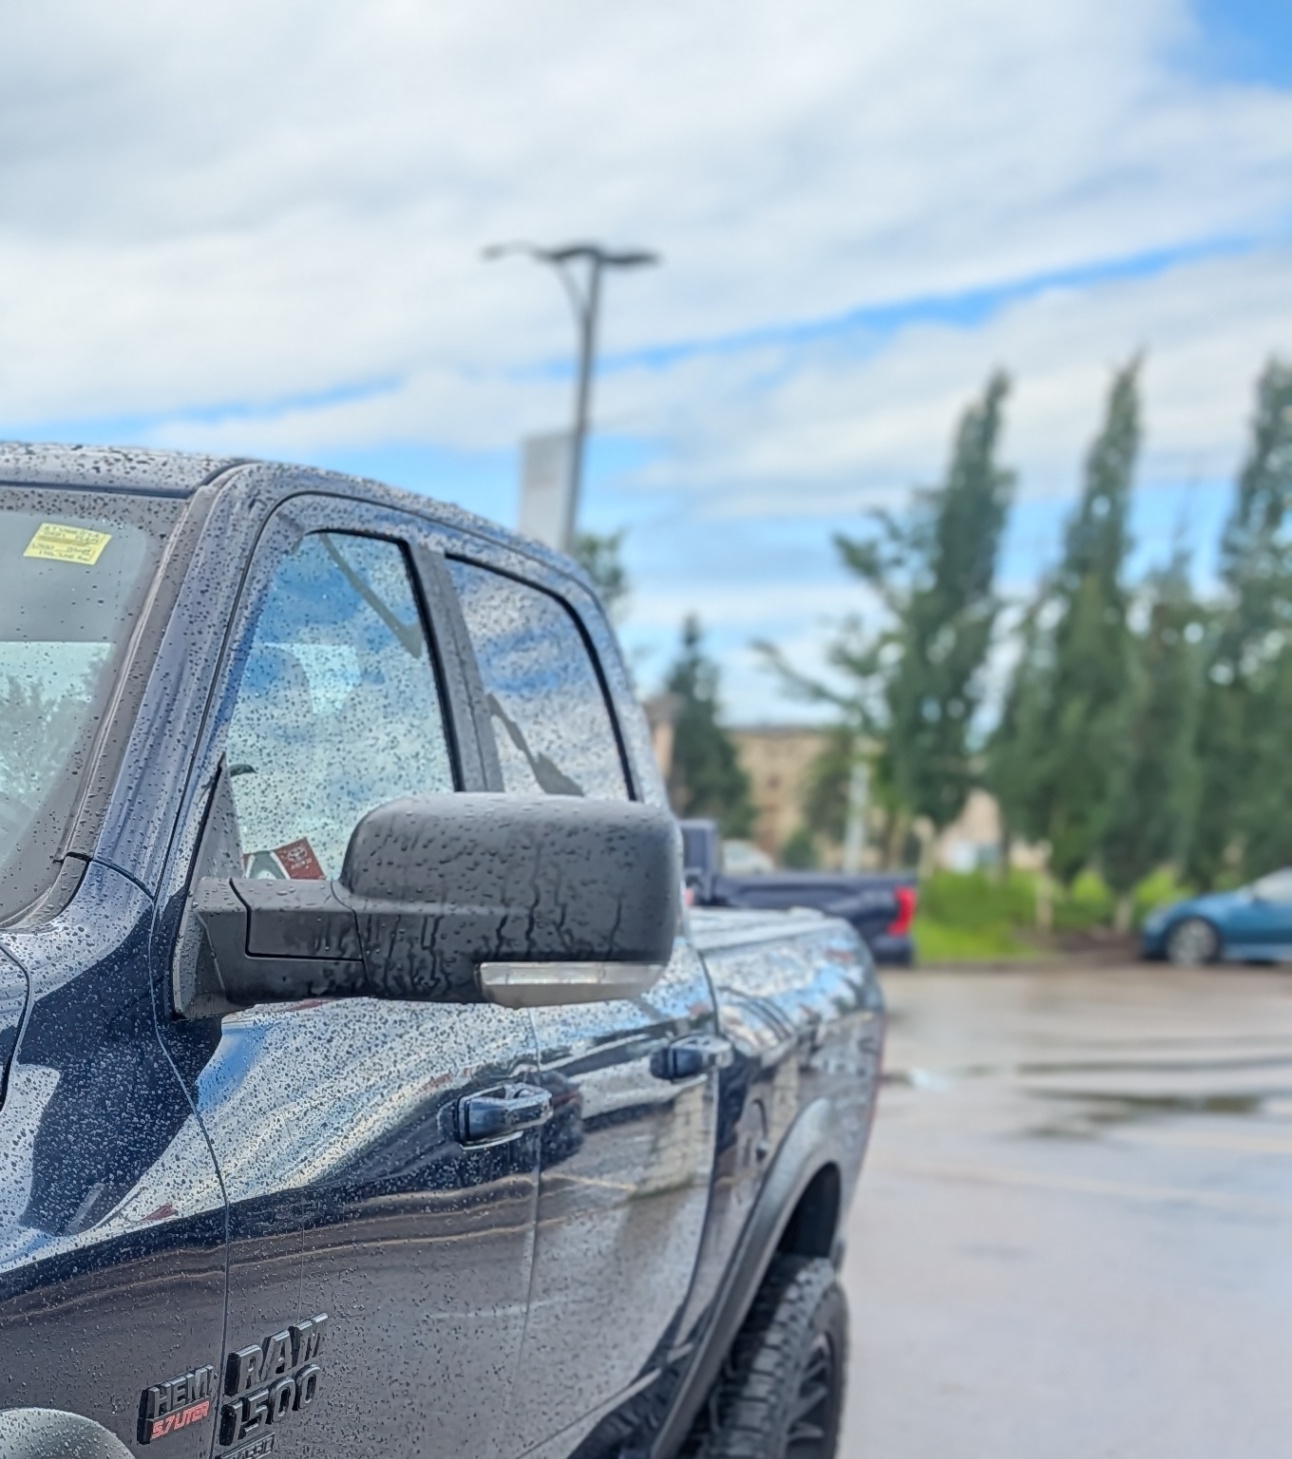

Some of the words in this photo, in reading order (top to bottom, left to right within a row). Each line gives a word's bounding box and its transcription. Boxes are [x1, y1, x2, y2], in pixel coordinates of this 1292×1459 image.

[140, 1364, 214, 1420] HEMI
[226, 1313, 328, 1396] RAM
[218, 1363, 320, 1446] 1500
